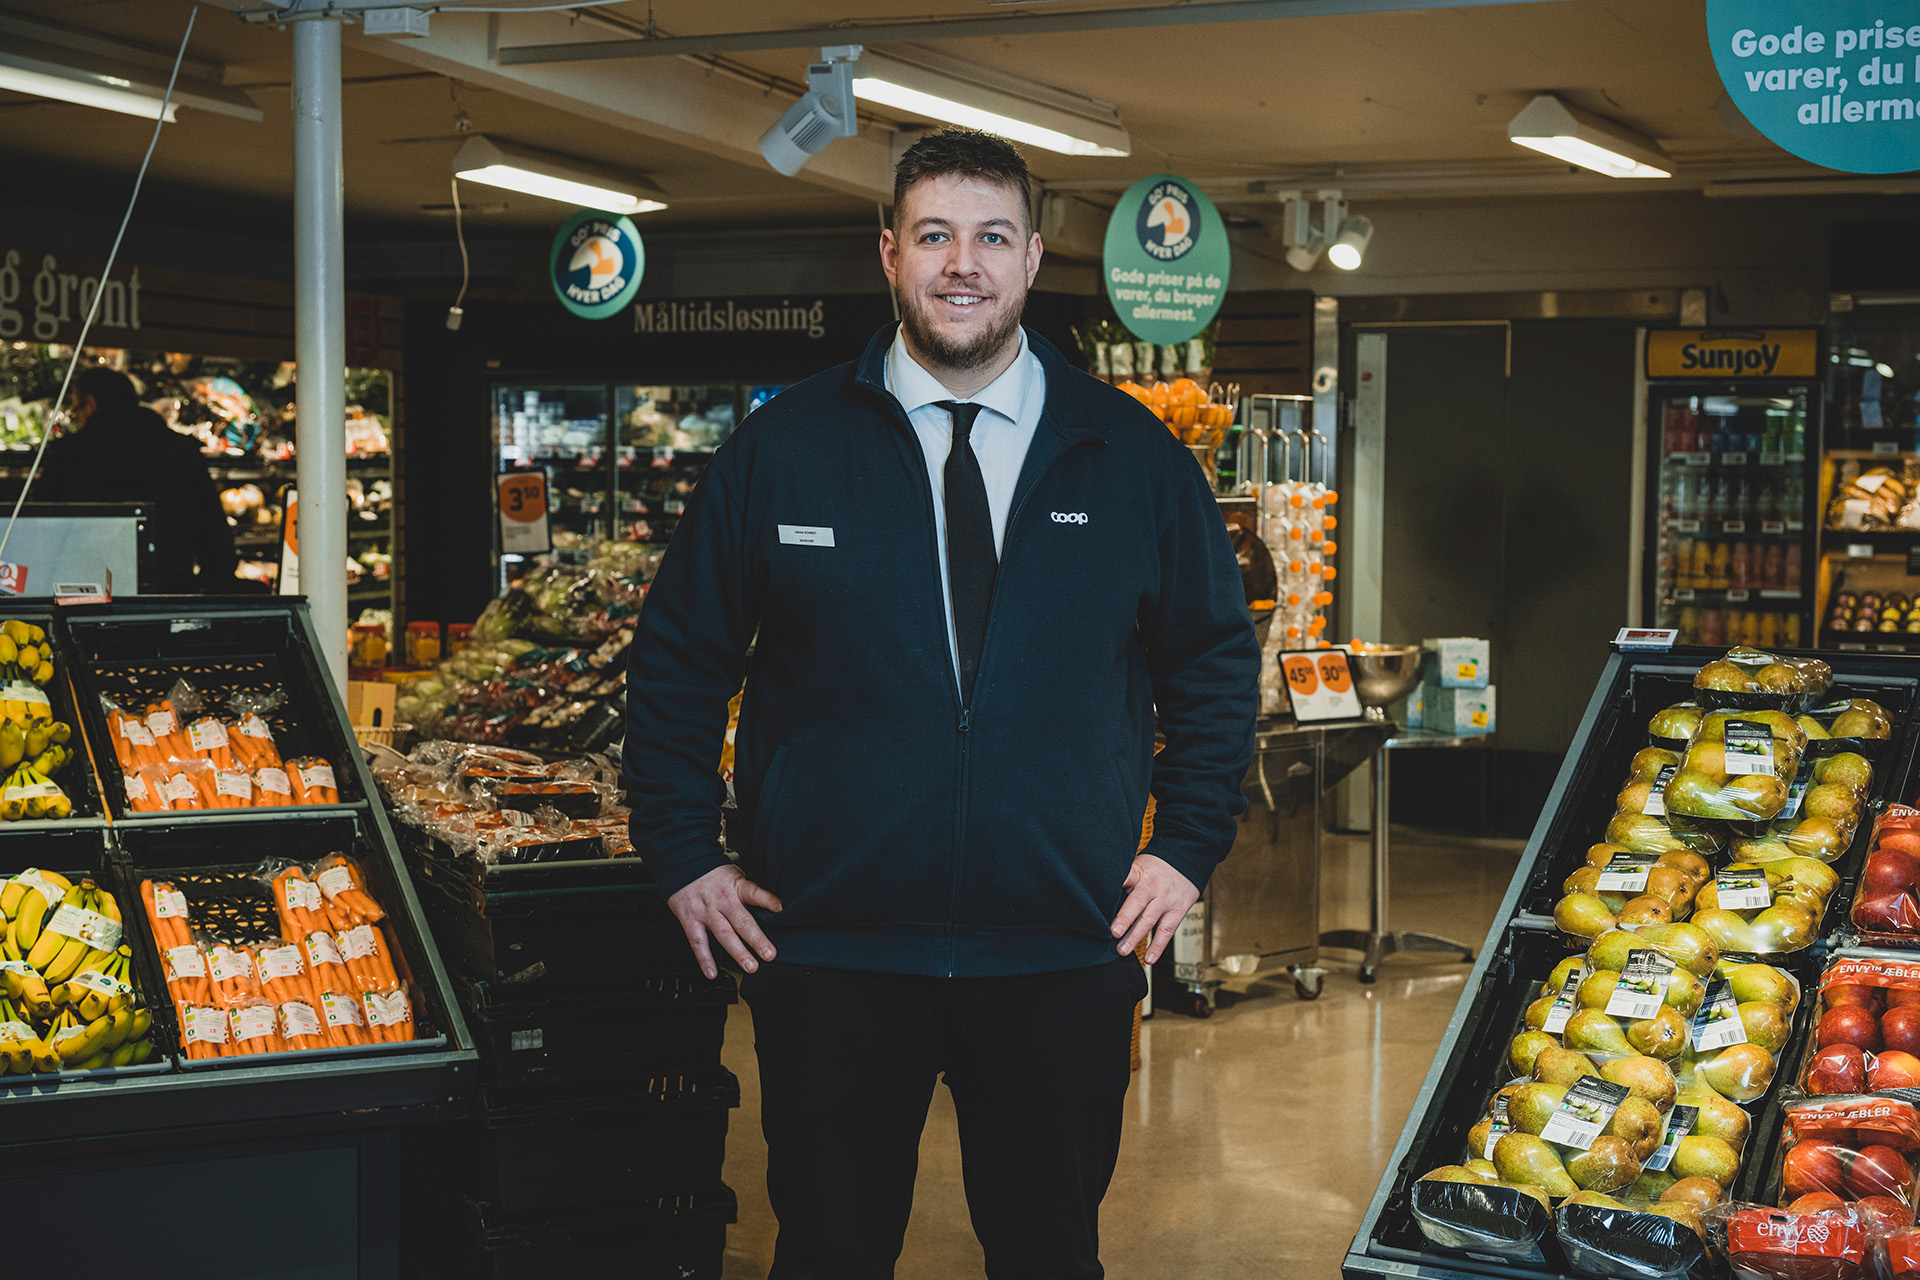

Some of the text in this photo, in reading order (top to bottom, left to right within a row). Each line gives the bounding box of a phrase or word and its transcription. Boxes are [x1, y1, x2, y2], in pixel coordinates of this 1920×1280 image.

[1731, 25, 1826, 58] Gode
[1744, 66, 1848, 94] varer,
[1857, 56, 1904, 87] du
[1797, 94, 1920, 125] allerm
[1165, 184, 1189, 204] PRIS
[1145, 238, 1173, 259] HVER
[1111, 267, 1221, 290] Gode priser på de
[1115, 288, 1216, 307] varer, du bruger
[633, 300, 825, 339] Måltidsløsning
[1132, 304, 1197, 321] allermest.
[1050, 511, 1089, 525] coop
[1883, 967, 1920, 979] ÆBLE
[1845, 1106, 1892, 1119] ÆBLER
[1757, 1221, 1808, 1248] envy
